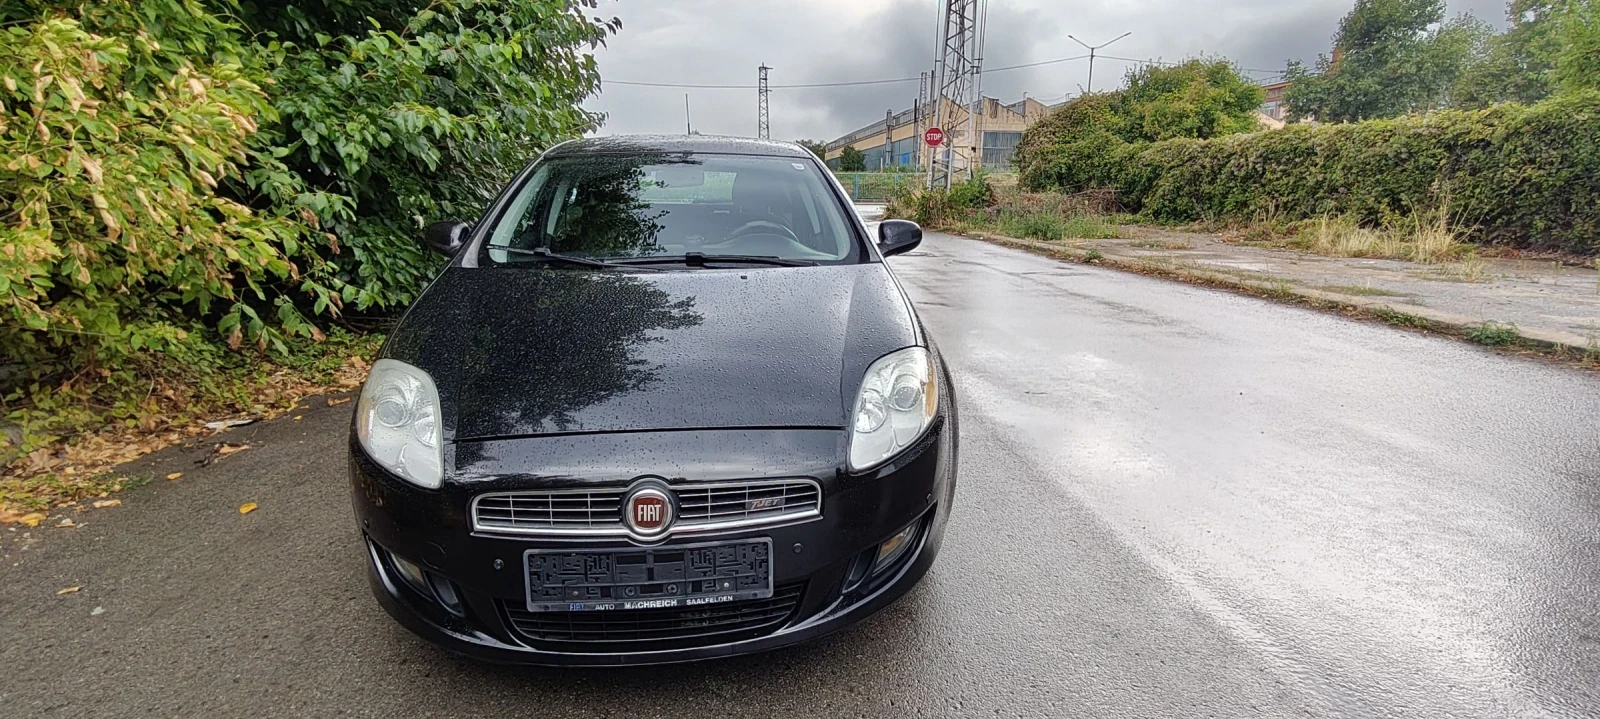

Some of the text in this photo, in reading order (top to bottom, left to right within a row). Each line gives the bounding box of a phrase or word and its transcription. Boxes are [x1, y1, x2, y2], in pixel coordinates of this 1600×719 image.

[926, 133, 942, 141] STOP
[637, 504, 662, 522] FIAT
[595, 603, 615, 611] AUTO
[624, 599, 678, 610] MACHREICH
[686, 595, 734, 606] SAALFELDEN
